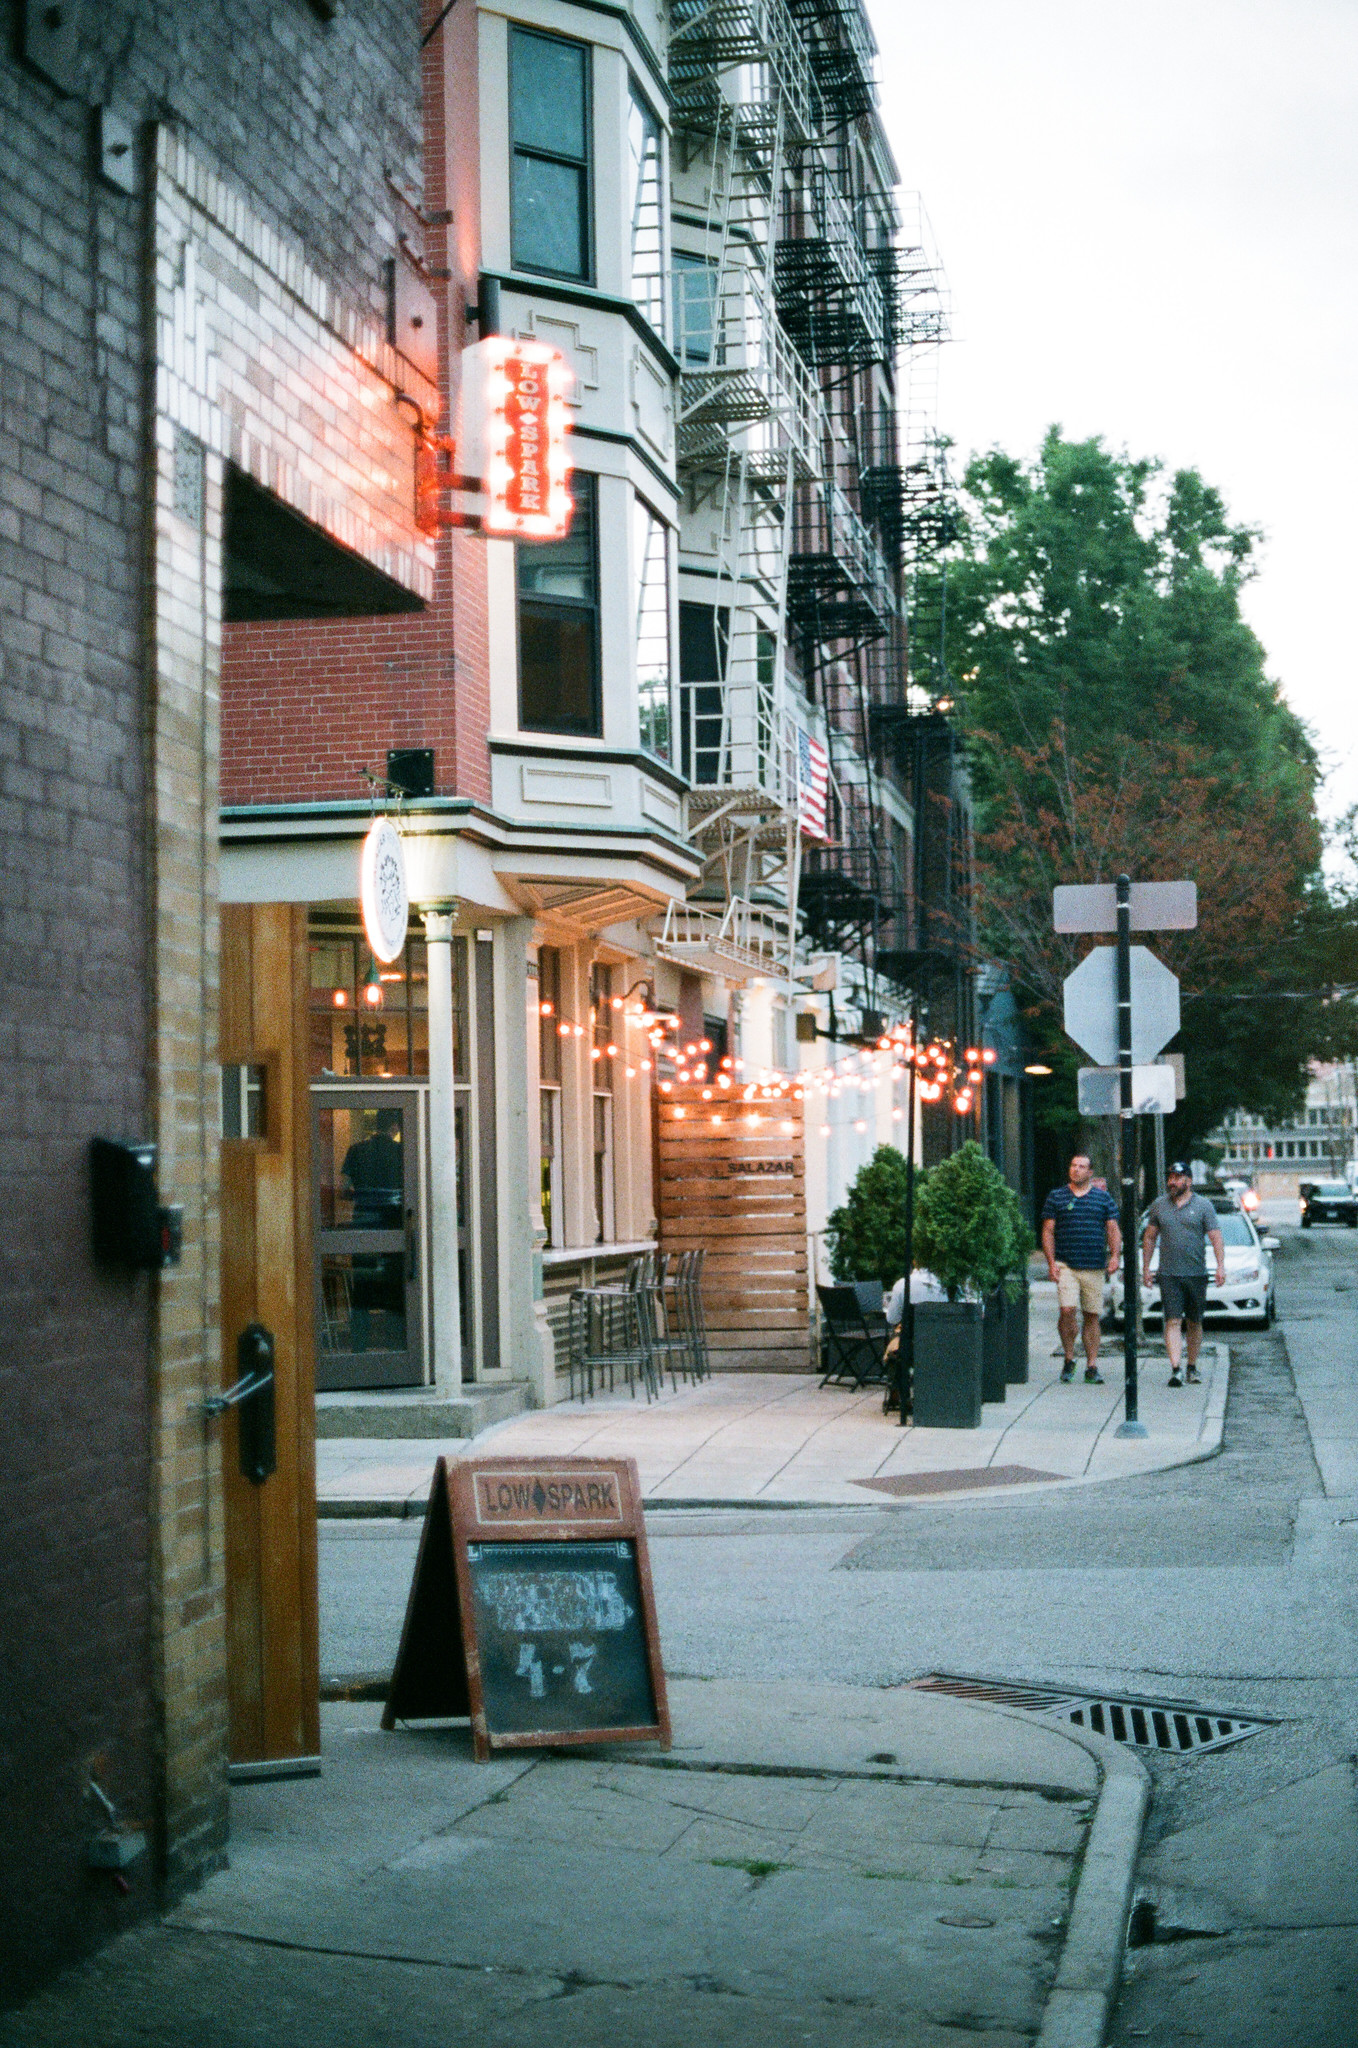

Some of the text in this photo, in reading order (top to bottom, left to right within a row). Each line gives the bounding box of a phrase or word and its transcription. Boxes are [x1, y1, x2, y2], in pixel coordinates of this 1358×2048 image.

[516, 362, 542, 509] LOW SPARK
[727, 1162, 794, 1173] SALAZAR
[484, 1482, 615, 1512] LOW SPARK
